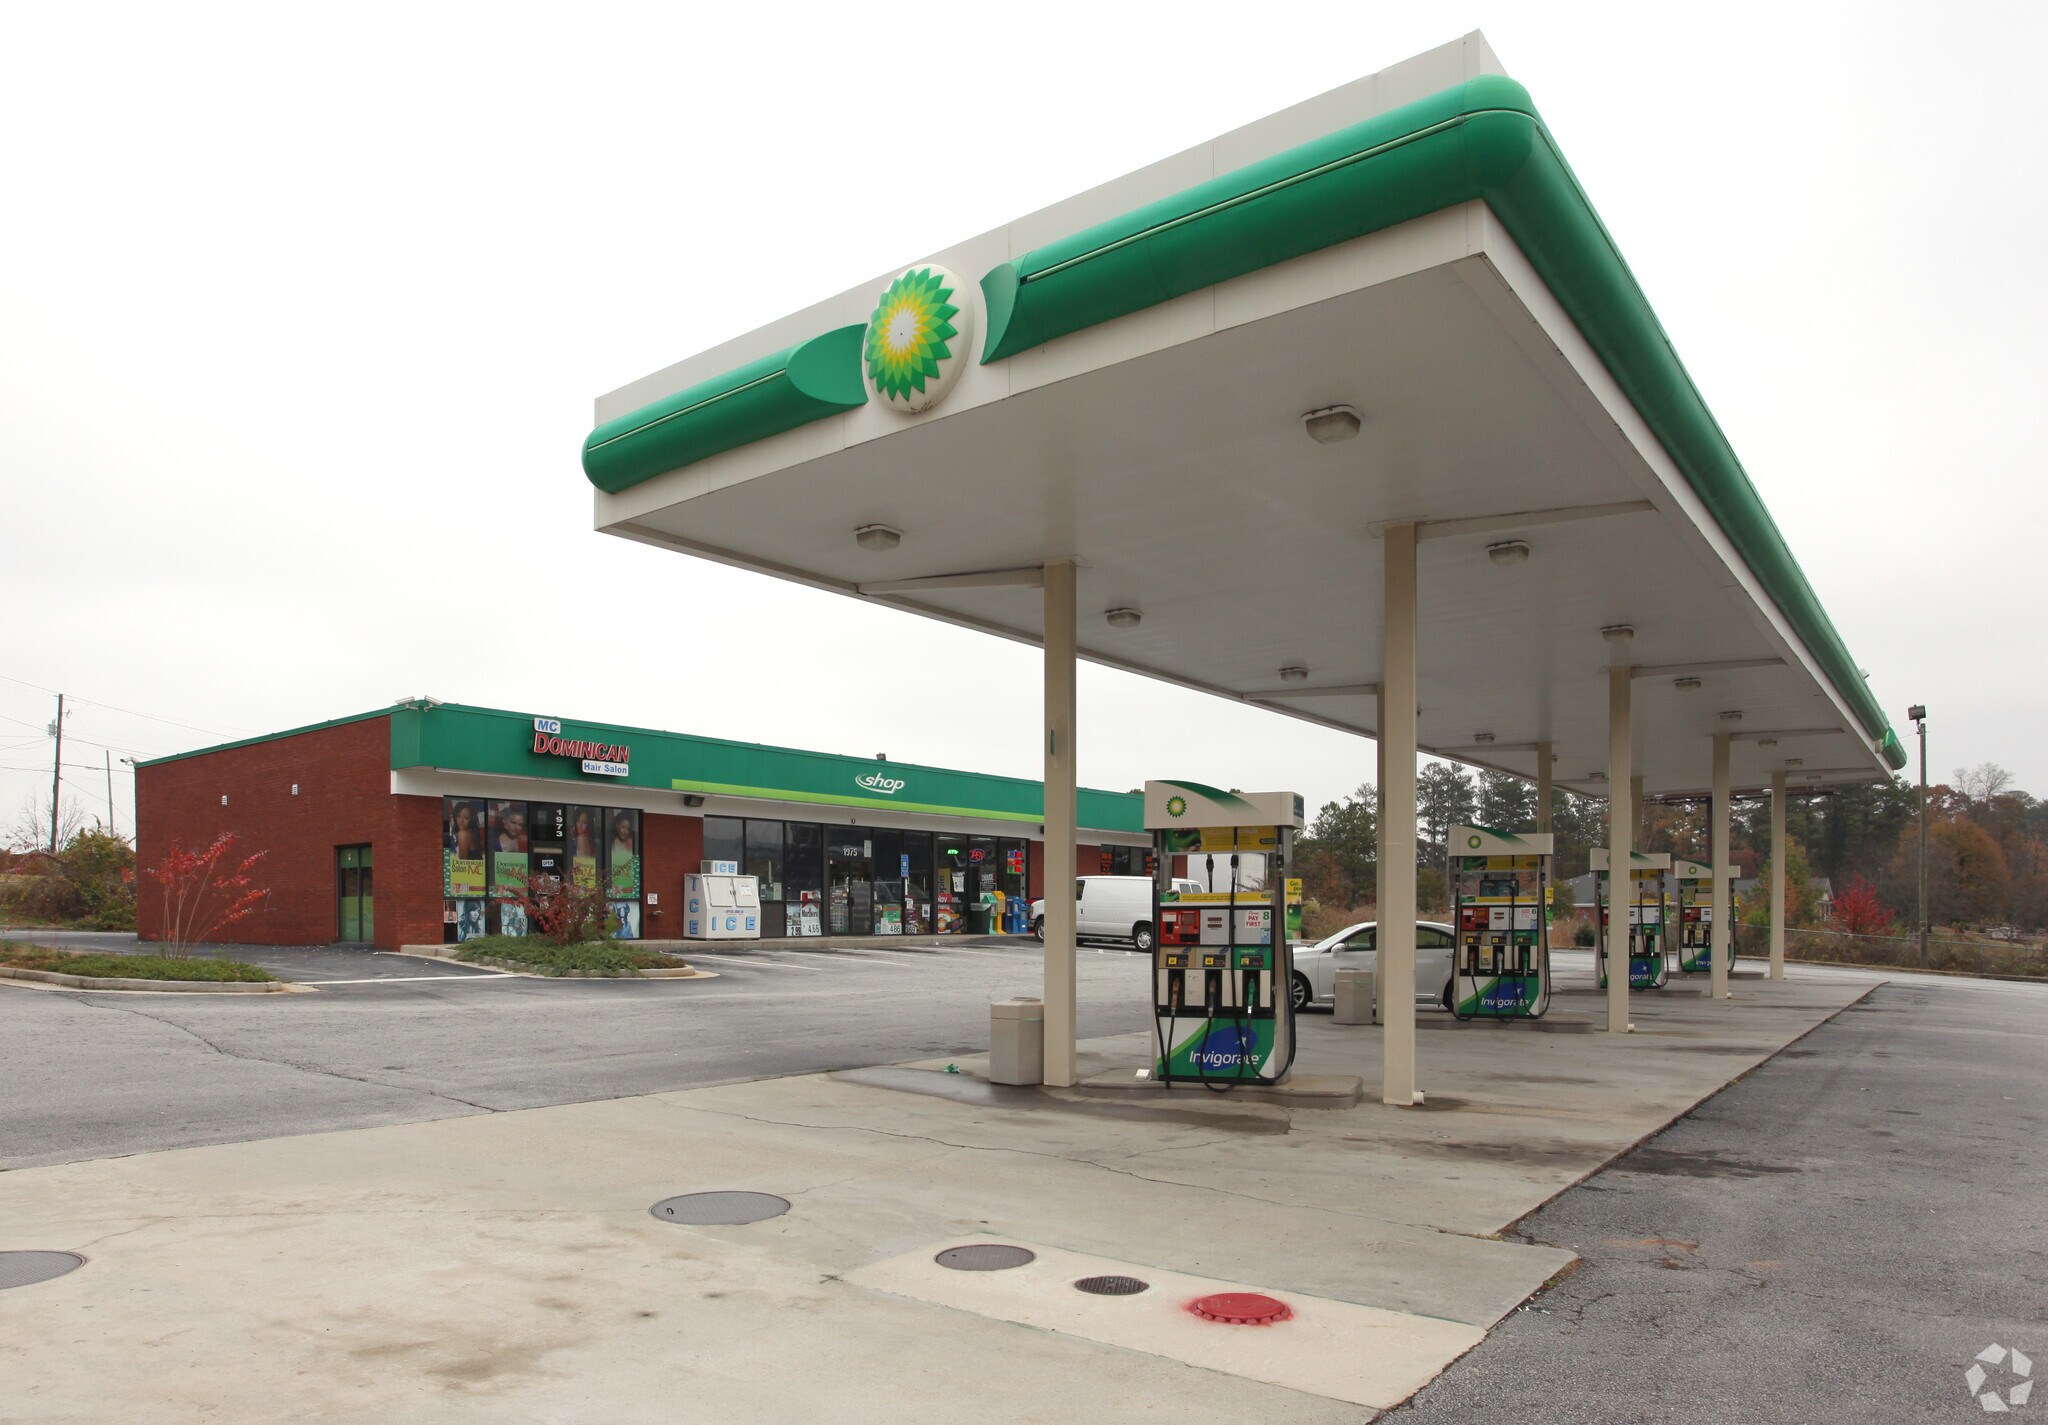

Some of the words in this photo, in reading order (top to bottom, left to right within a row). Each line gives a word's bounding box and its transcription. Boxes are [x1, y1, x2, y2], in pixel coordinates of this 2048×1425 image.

[537, 719, 559, 732] MC
[533, 732, 630, 763] DOMINICAN
[584, 762, 601, 771] Hair
[604, 763, 627, 774] Salon
[865, 772, 905, 794] shop
[555, 809, 563, 837] 1973
[714, 862, 736, 873] ICE
[1263, 911, 1270, 920] 8
[711, 916, 756, 931] ICE
